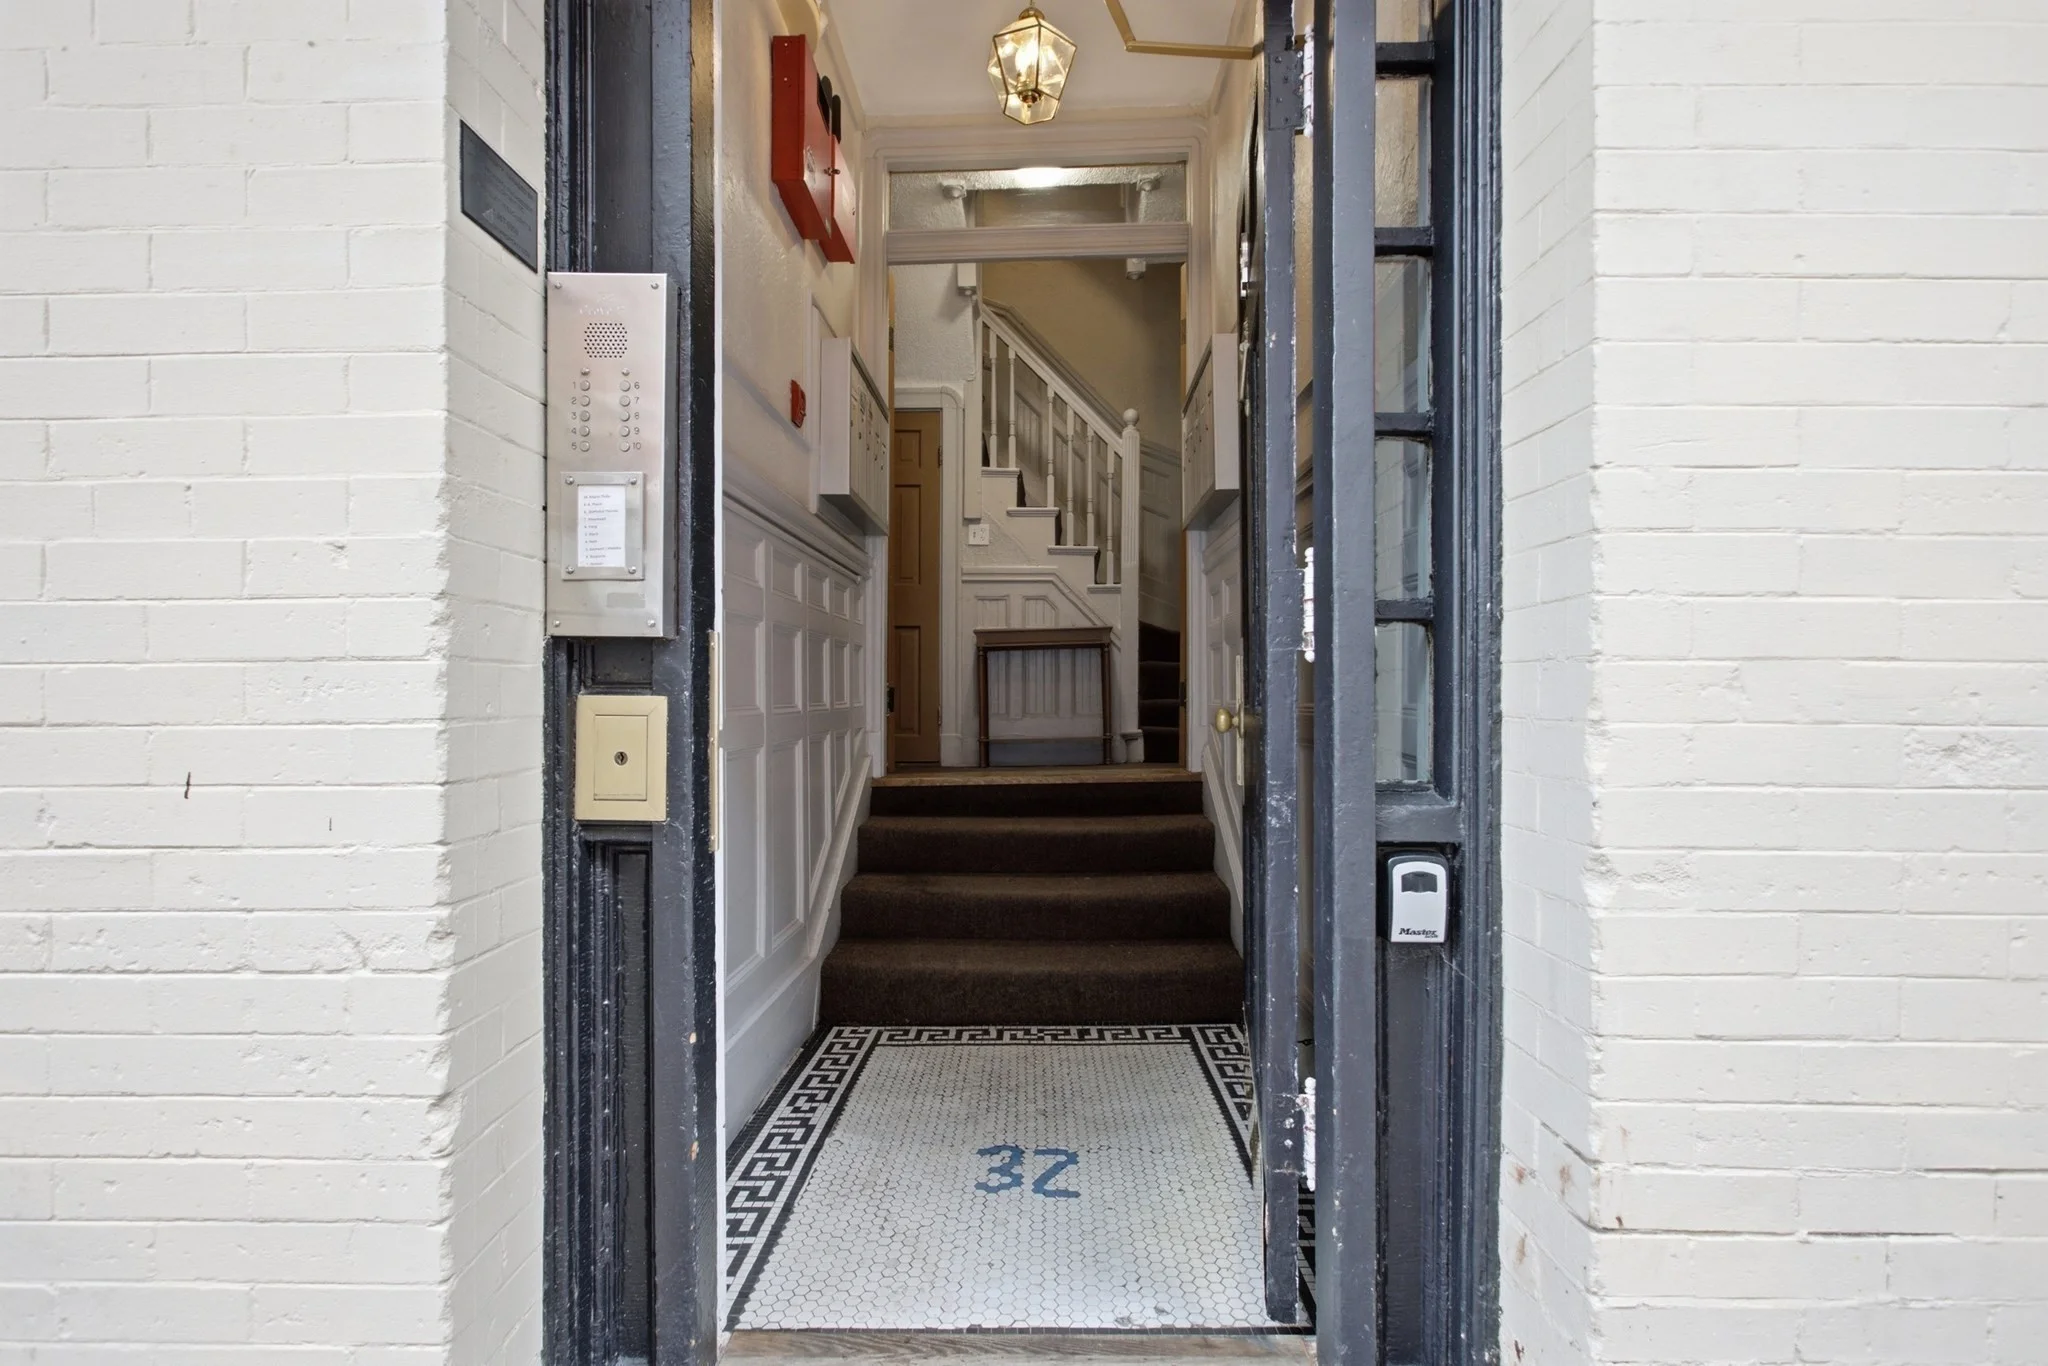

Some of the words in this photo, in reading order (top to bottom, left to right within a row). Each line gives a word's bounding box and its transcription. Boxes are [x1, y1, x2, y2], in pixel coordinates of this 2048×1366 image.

[571, 442, 577, 450] 5
[632, 442, 642, 450] 10
[1398, 927, 1438, 936] Master
[974, 1144, 1081, 1198] 32
